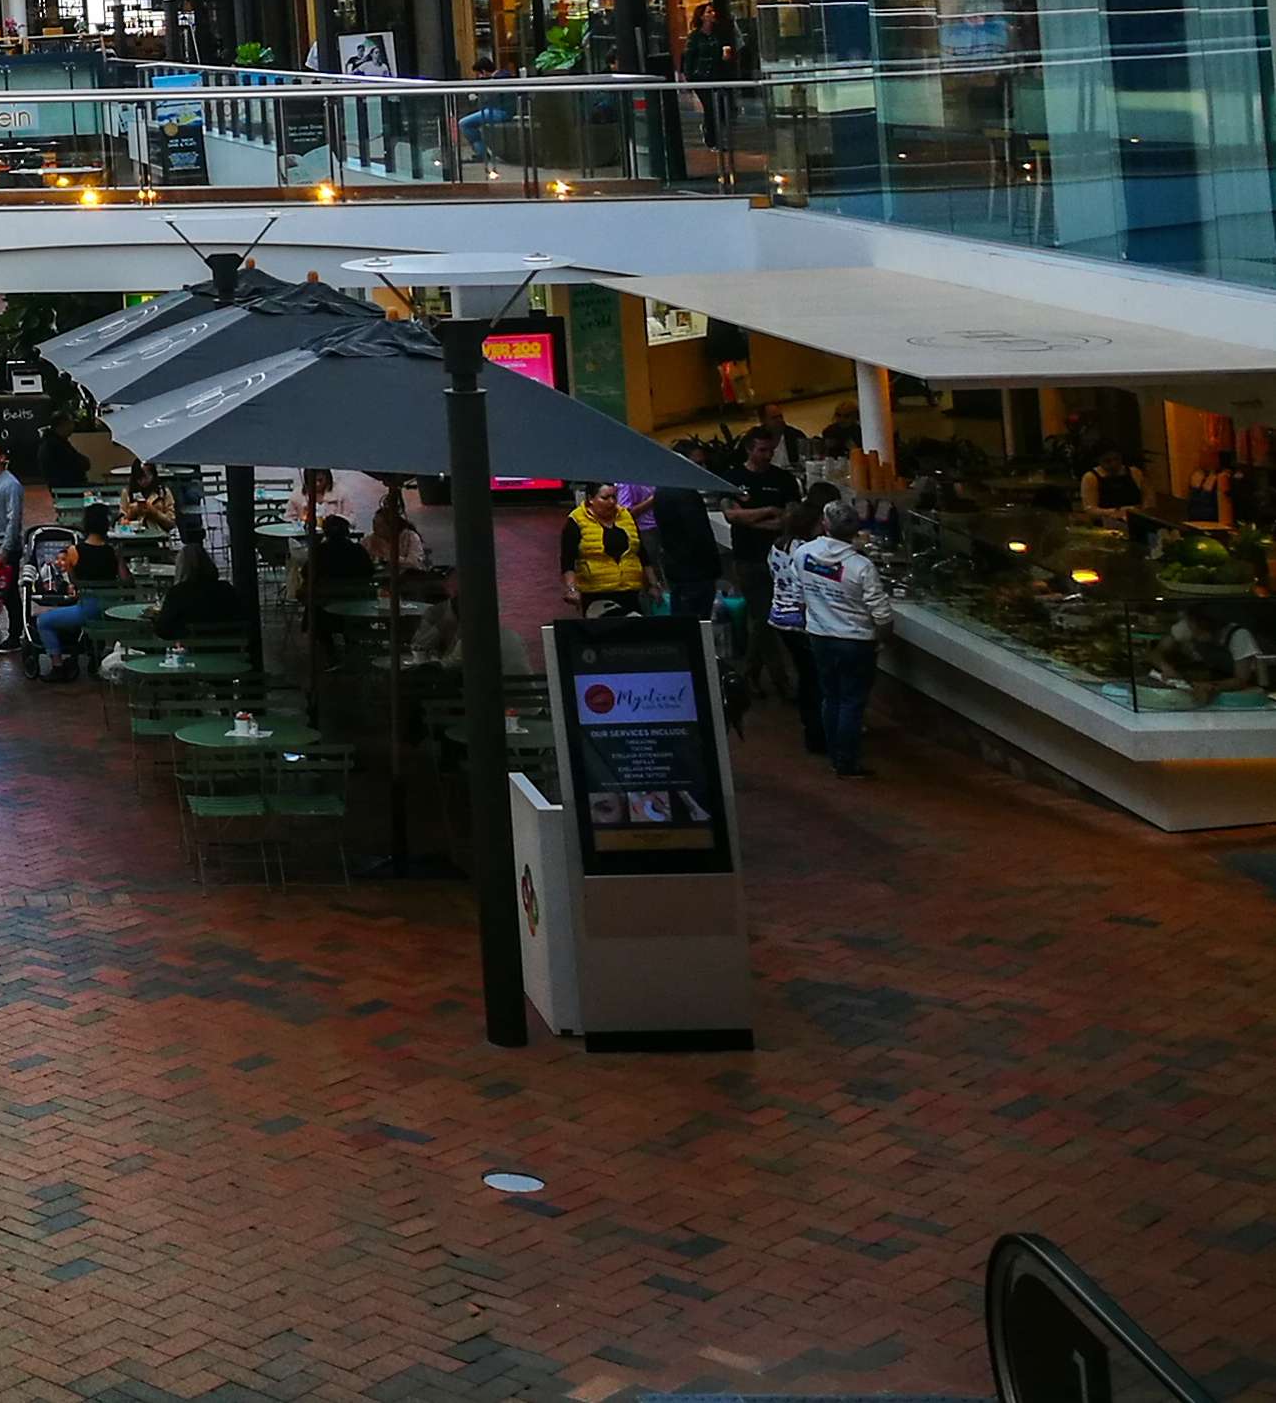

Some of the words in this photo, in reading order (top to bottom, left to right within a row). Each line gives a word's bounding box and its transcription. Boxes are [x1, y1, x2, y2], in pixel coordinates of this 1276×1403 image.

[485, 342, 510, 356] VER
[512, 342, 541, 354] 200
[617, 685, 686, 712] Mystical
